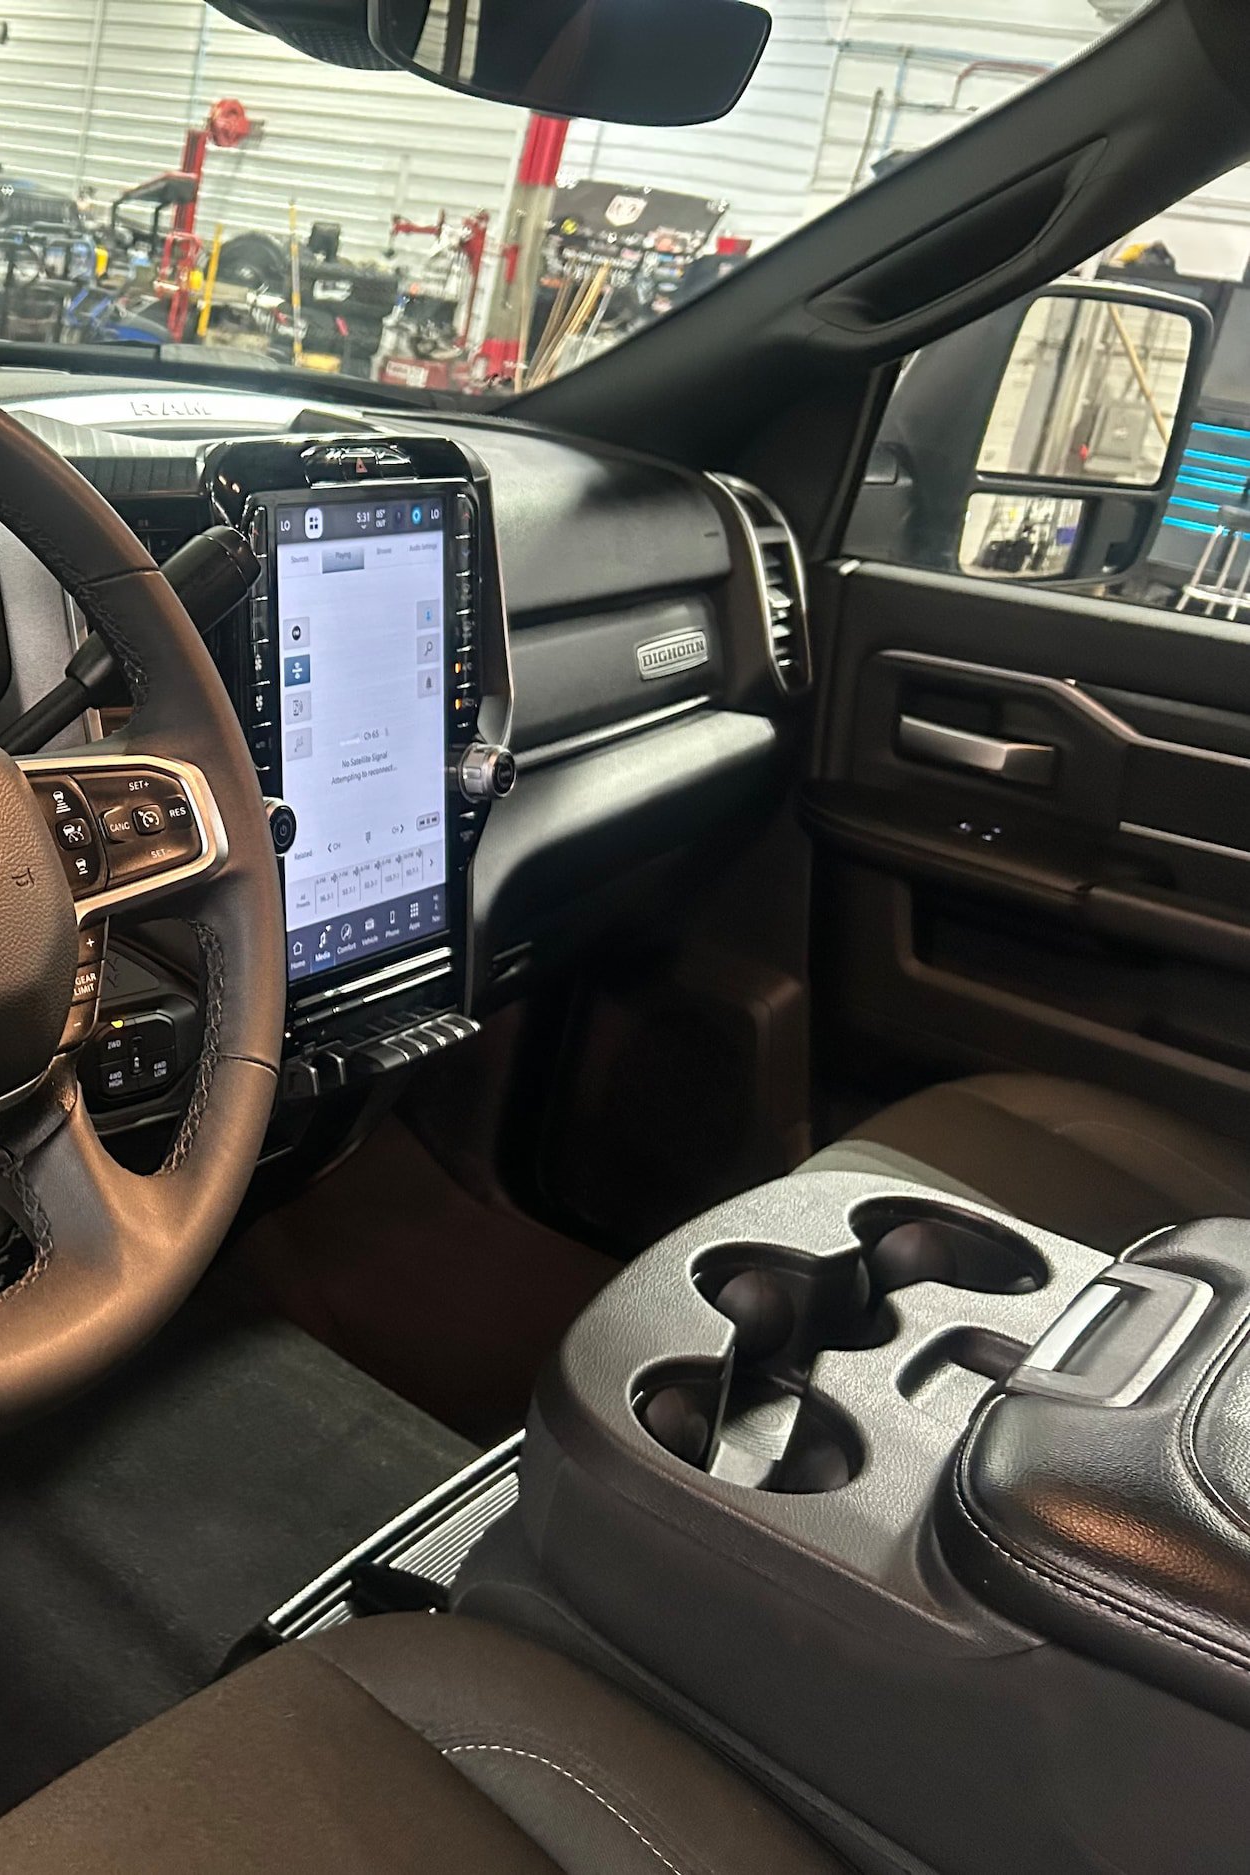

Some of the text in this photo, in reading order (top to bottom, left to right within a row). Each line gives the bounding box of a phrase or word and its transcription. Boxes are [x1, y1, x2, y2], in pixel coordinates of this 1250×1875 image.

[356, 512, 370, 524] 5:31
[280, 520, 291, 532] LO
[341, 751, 388, 769] No Satellite Signal
[331, 772, 361, 785] Attempting
[169, 806, 187, 818] RES
[110, 822, 130, 833] CANC
[74, 972, 97, 986] GEAR
[73, 983, 96, 997] LIMIT
[107, 1039, 122, 1050] 2WD
[153, 1060, 167, 1071] 4WD
[109, 1070, 123, 1081] 4WD
[154, 1067, 167, 1078] LOW
[108, 1078, 124, 1088] HIGH
